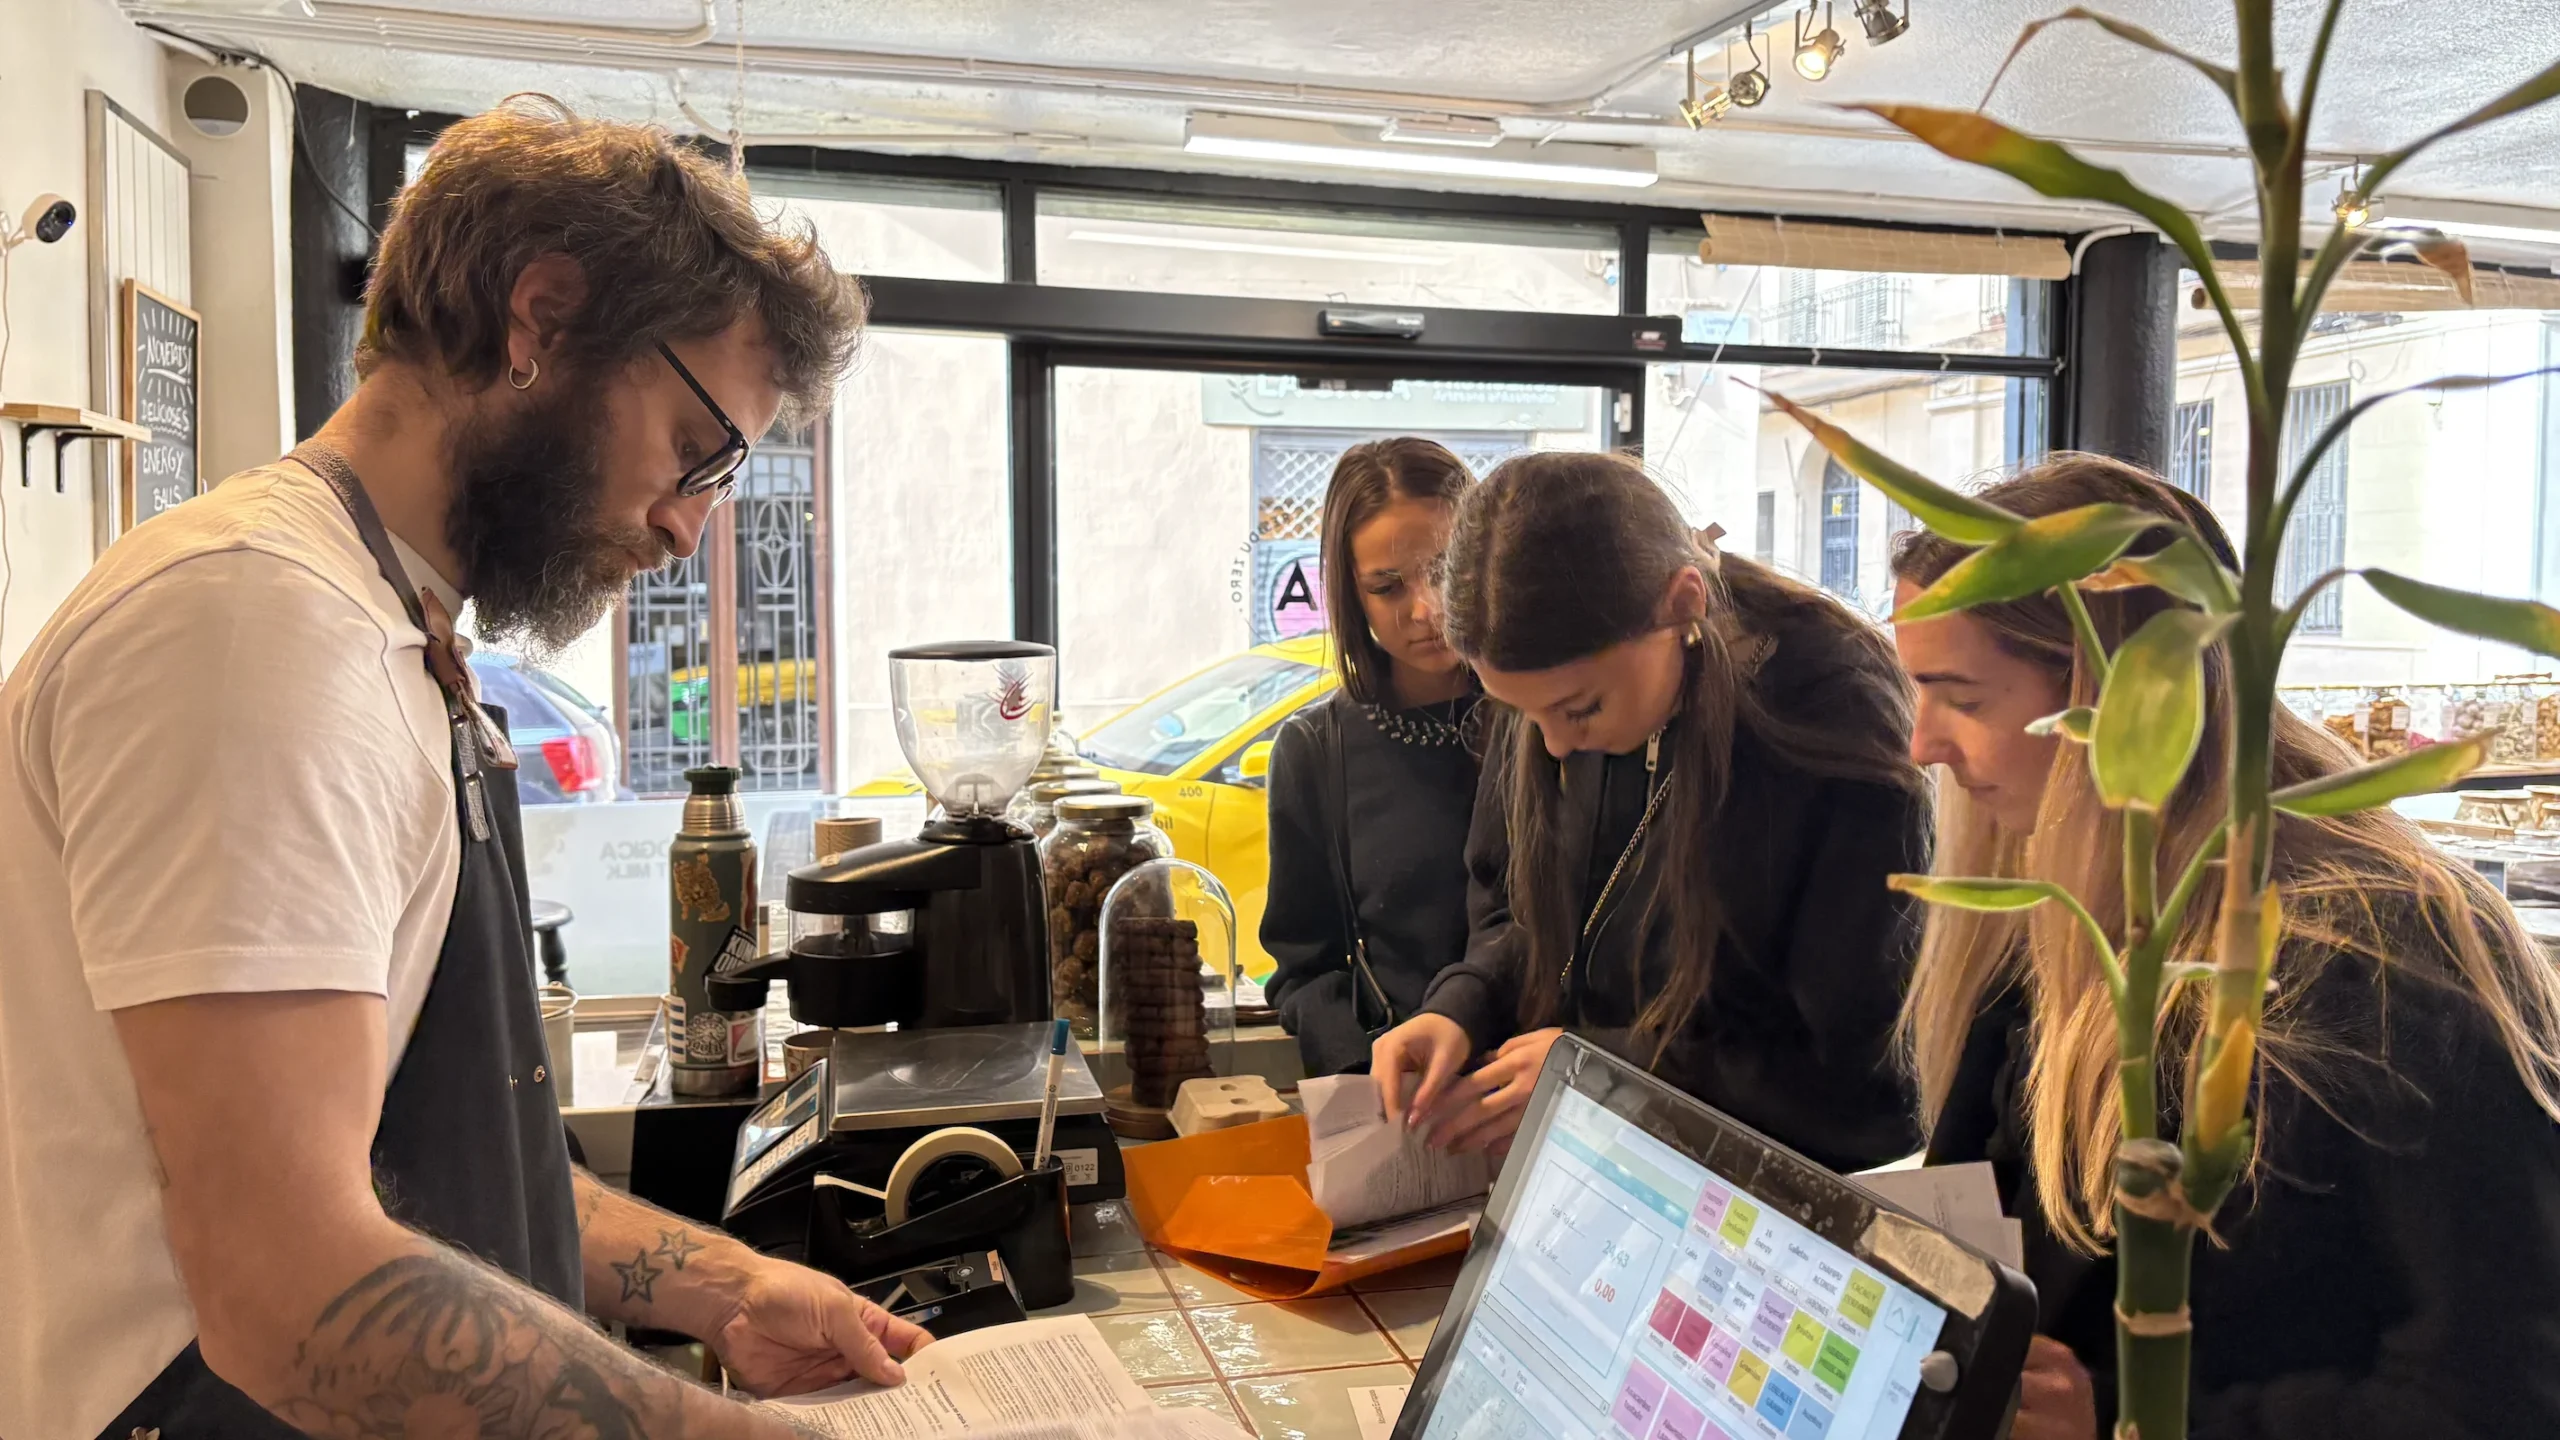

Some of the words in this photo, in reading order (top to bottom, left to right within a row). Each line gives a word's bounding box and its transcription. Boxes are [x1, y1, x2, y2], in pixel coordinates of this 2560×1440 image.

[142, 446, 184, 480] ENERGY
[153, 484, 182, 511] BALLS
[1074, 1163, 1096, 1173] 0122
[1594, 1278, 1616, 1303] 0,00
